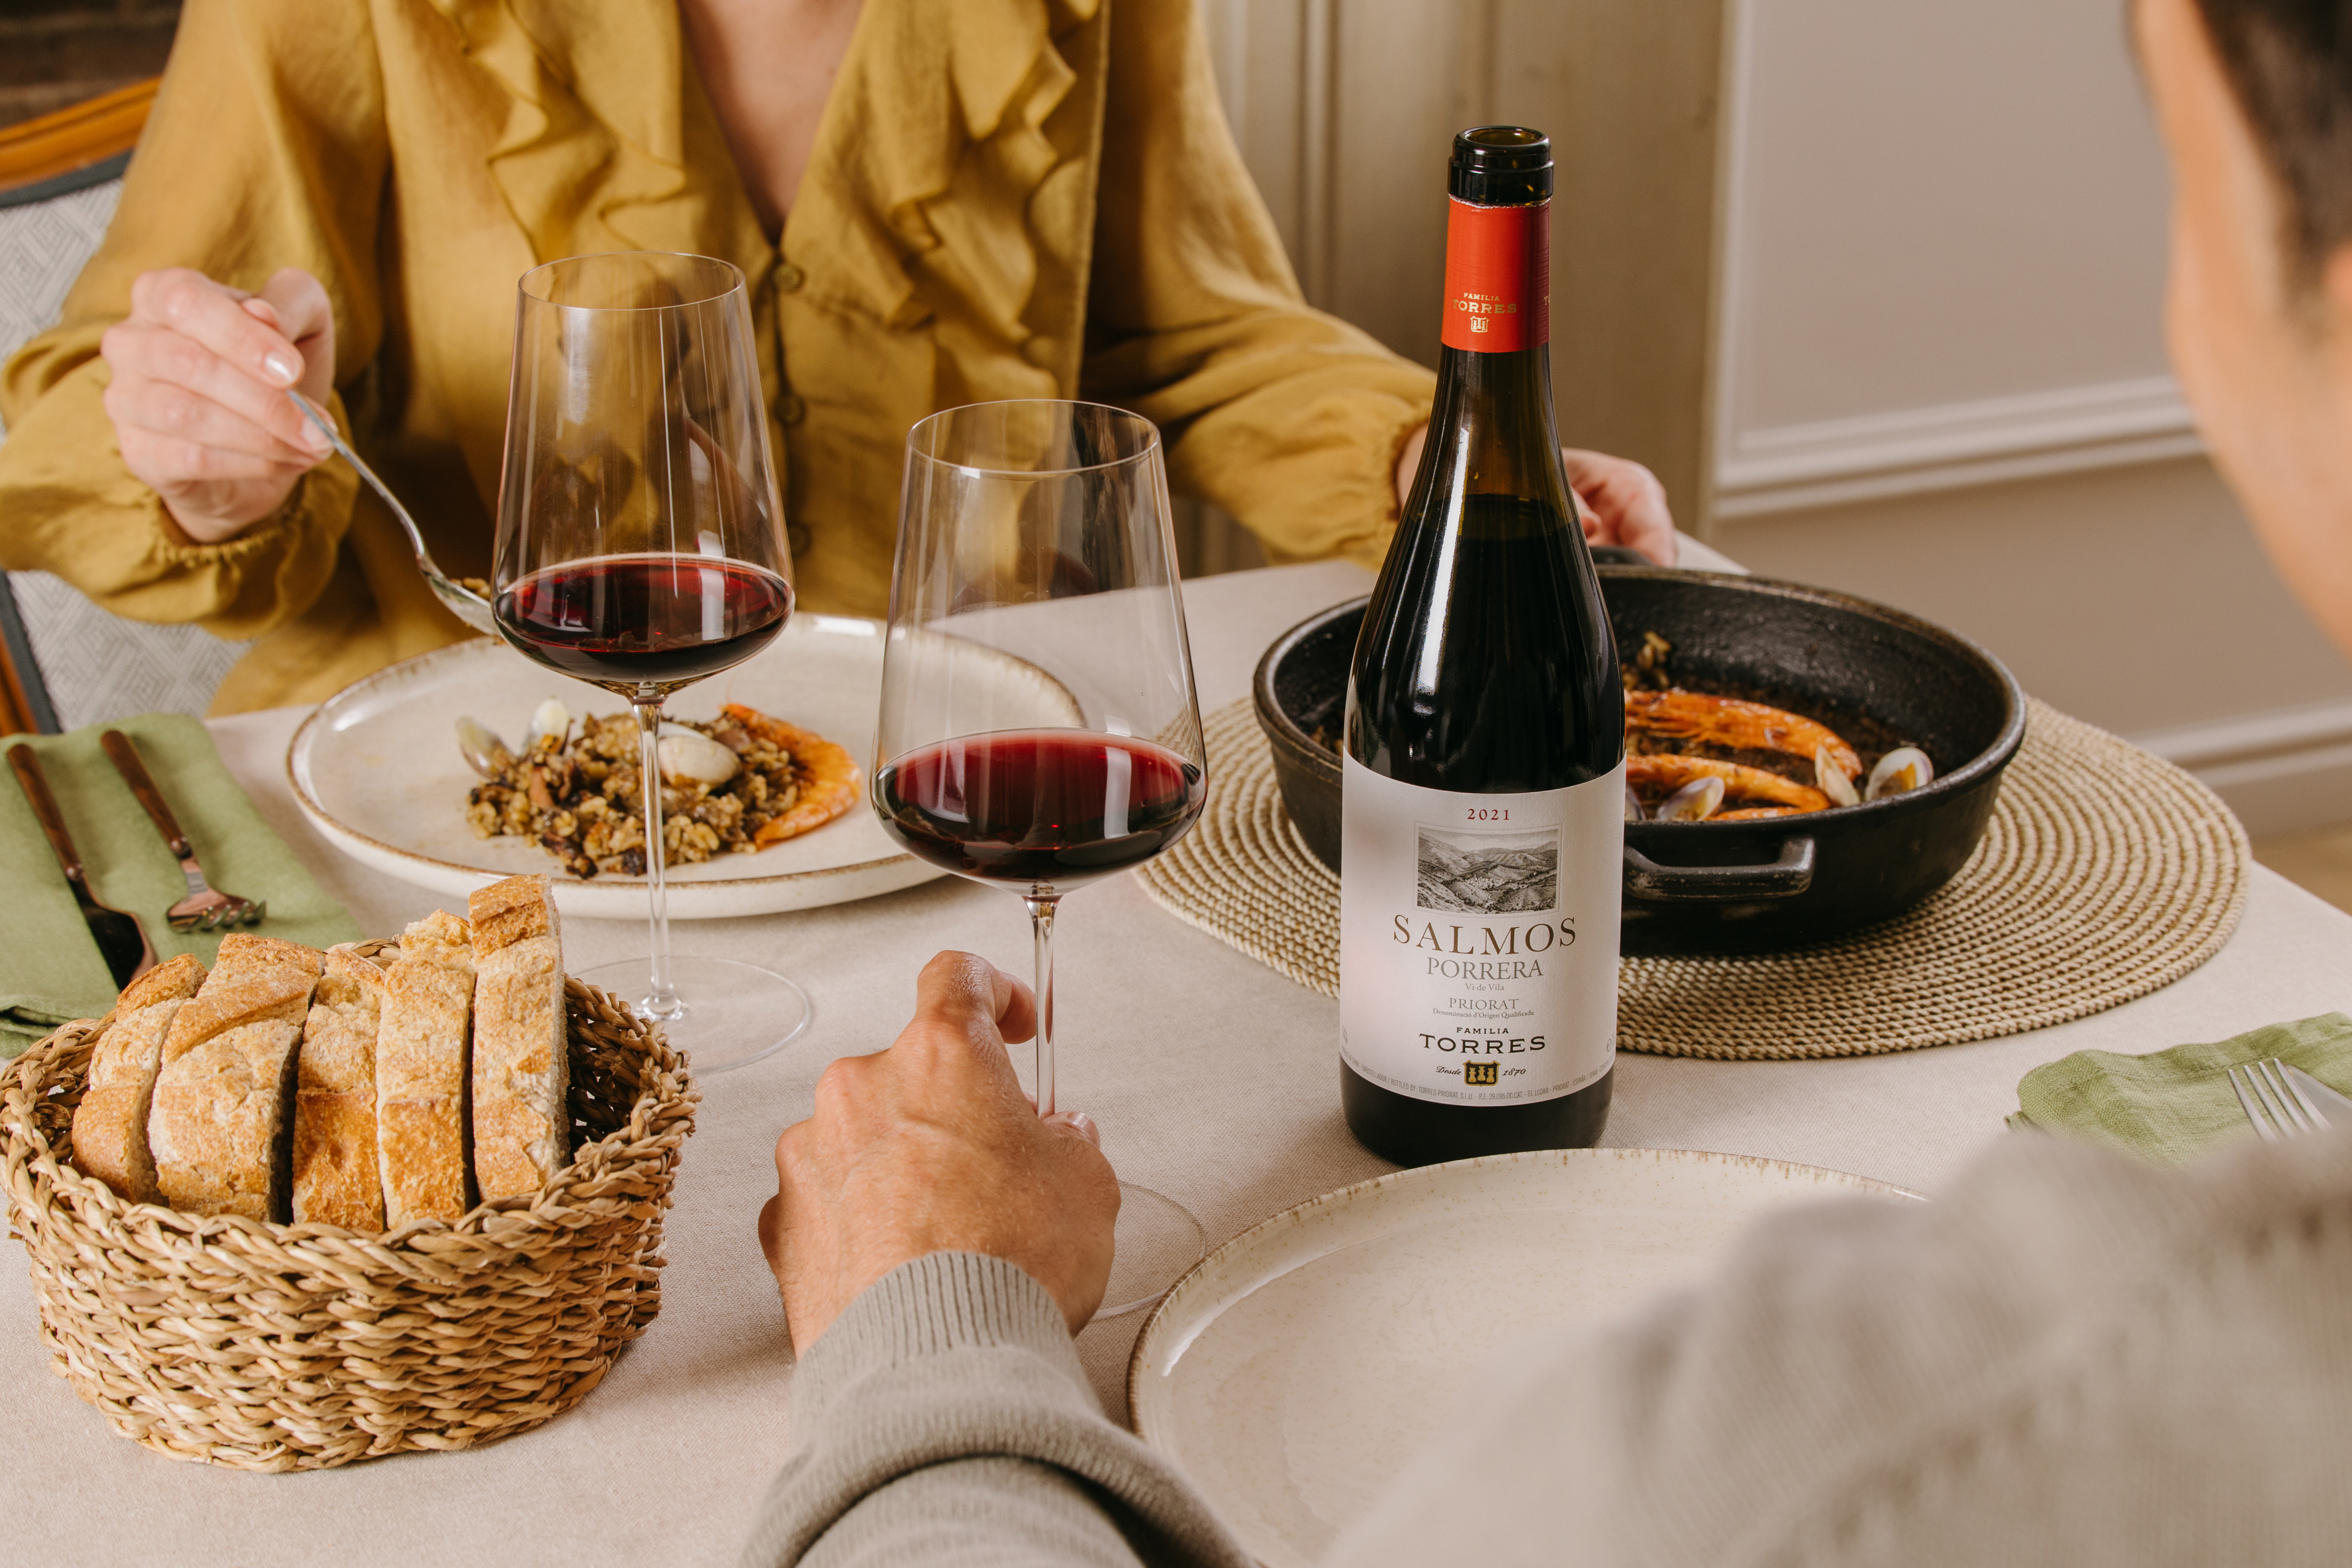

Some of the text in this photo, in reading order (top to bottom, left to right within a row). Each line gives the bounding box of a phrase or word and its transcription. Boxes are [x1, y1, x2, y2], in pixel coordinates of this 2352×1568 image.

[1464, 293, 1500, 301] FAMILIA
[1452, 299, 1517, 313] TORRES
[1467, 809, 1509, 820] 2021
[1394, 915, 1576, 955] SALMOS
[1426, 957, 1544, 980] PORRERA
[1448, 998, 1519, 1010] PRIORAT
[1433, 1008, 1472, 1017] Denominació
[1501, 1010, 1534, 1019] Qualificada
[1419, 1033, 1546, 1054] TORRES
[1436, 1066, 1526, 1076] Desde 1870
[1361, 1064, 1387, 1082] EMBOTELLADOR
[1391, 1078, 1409, 1089] BOTTLED
[1418, 1086, 1436, 1096] TORRES
[1535, 1087, 1549, 1096] LLOAR
[1553, 1082, 1569, 1092] PRIORAT
[1573, 1075, 1586, 1086] ESPAÑA
